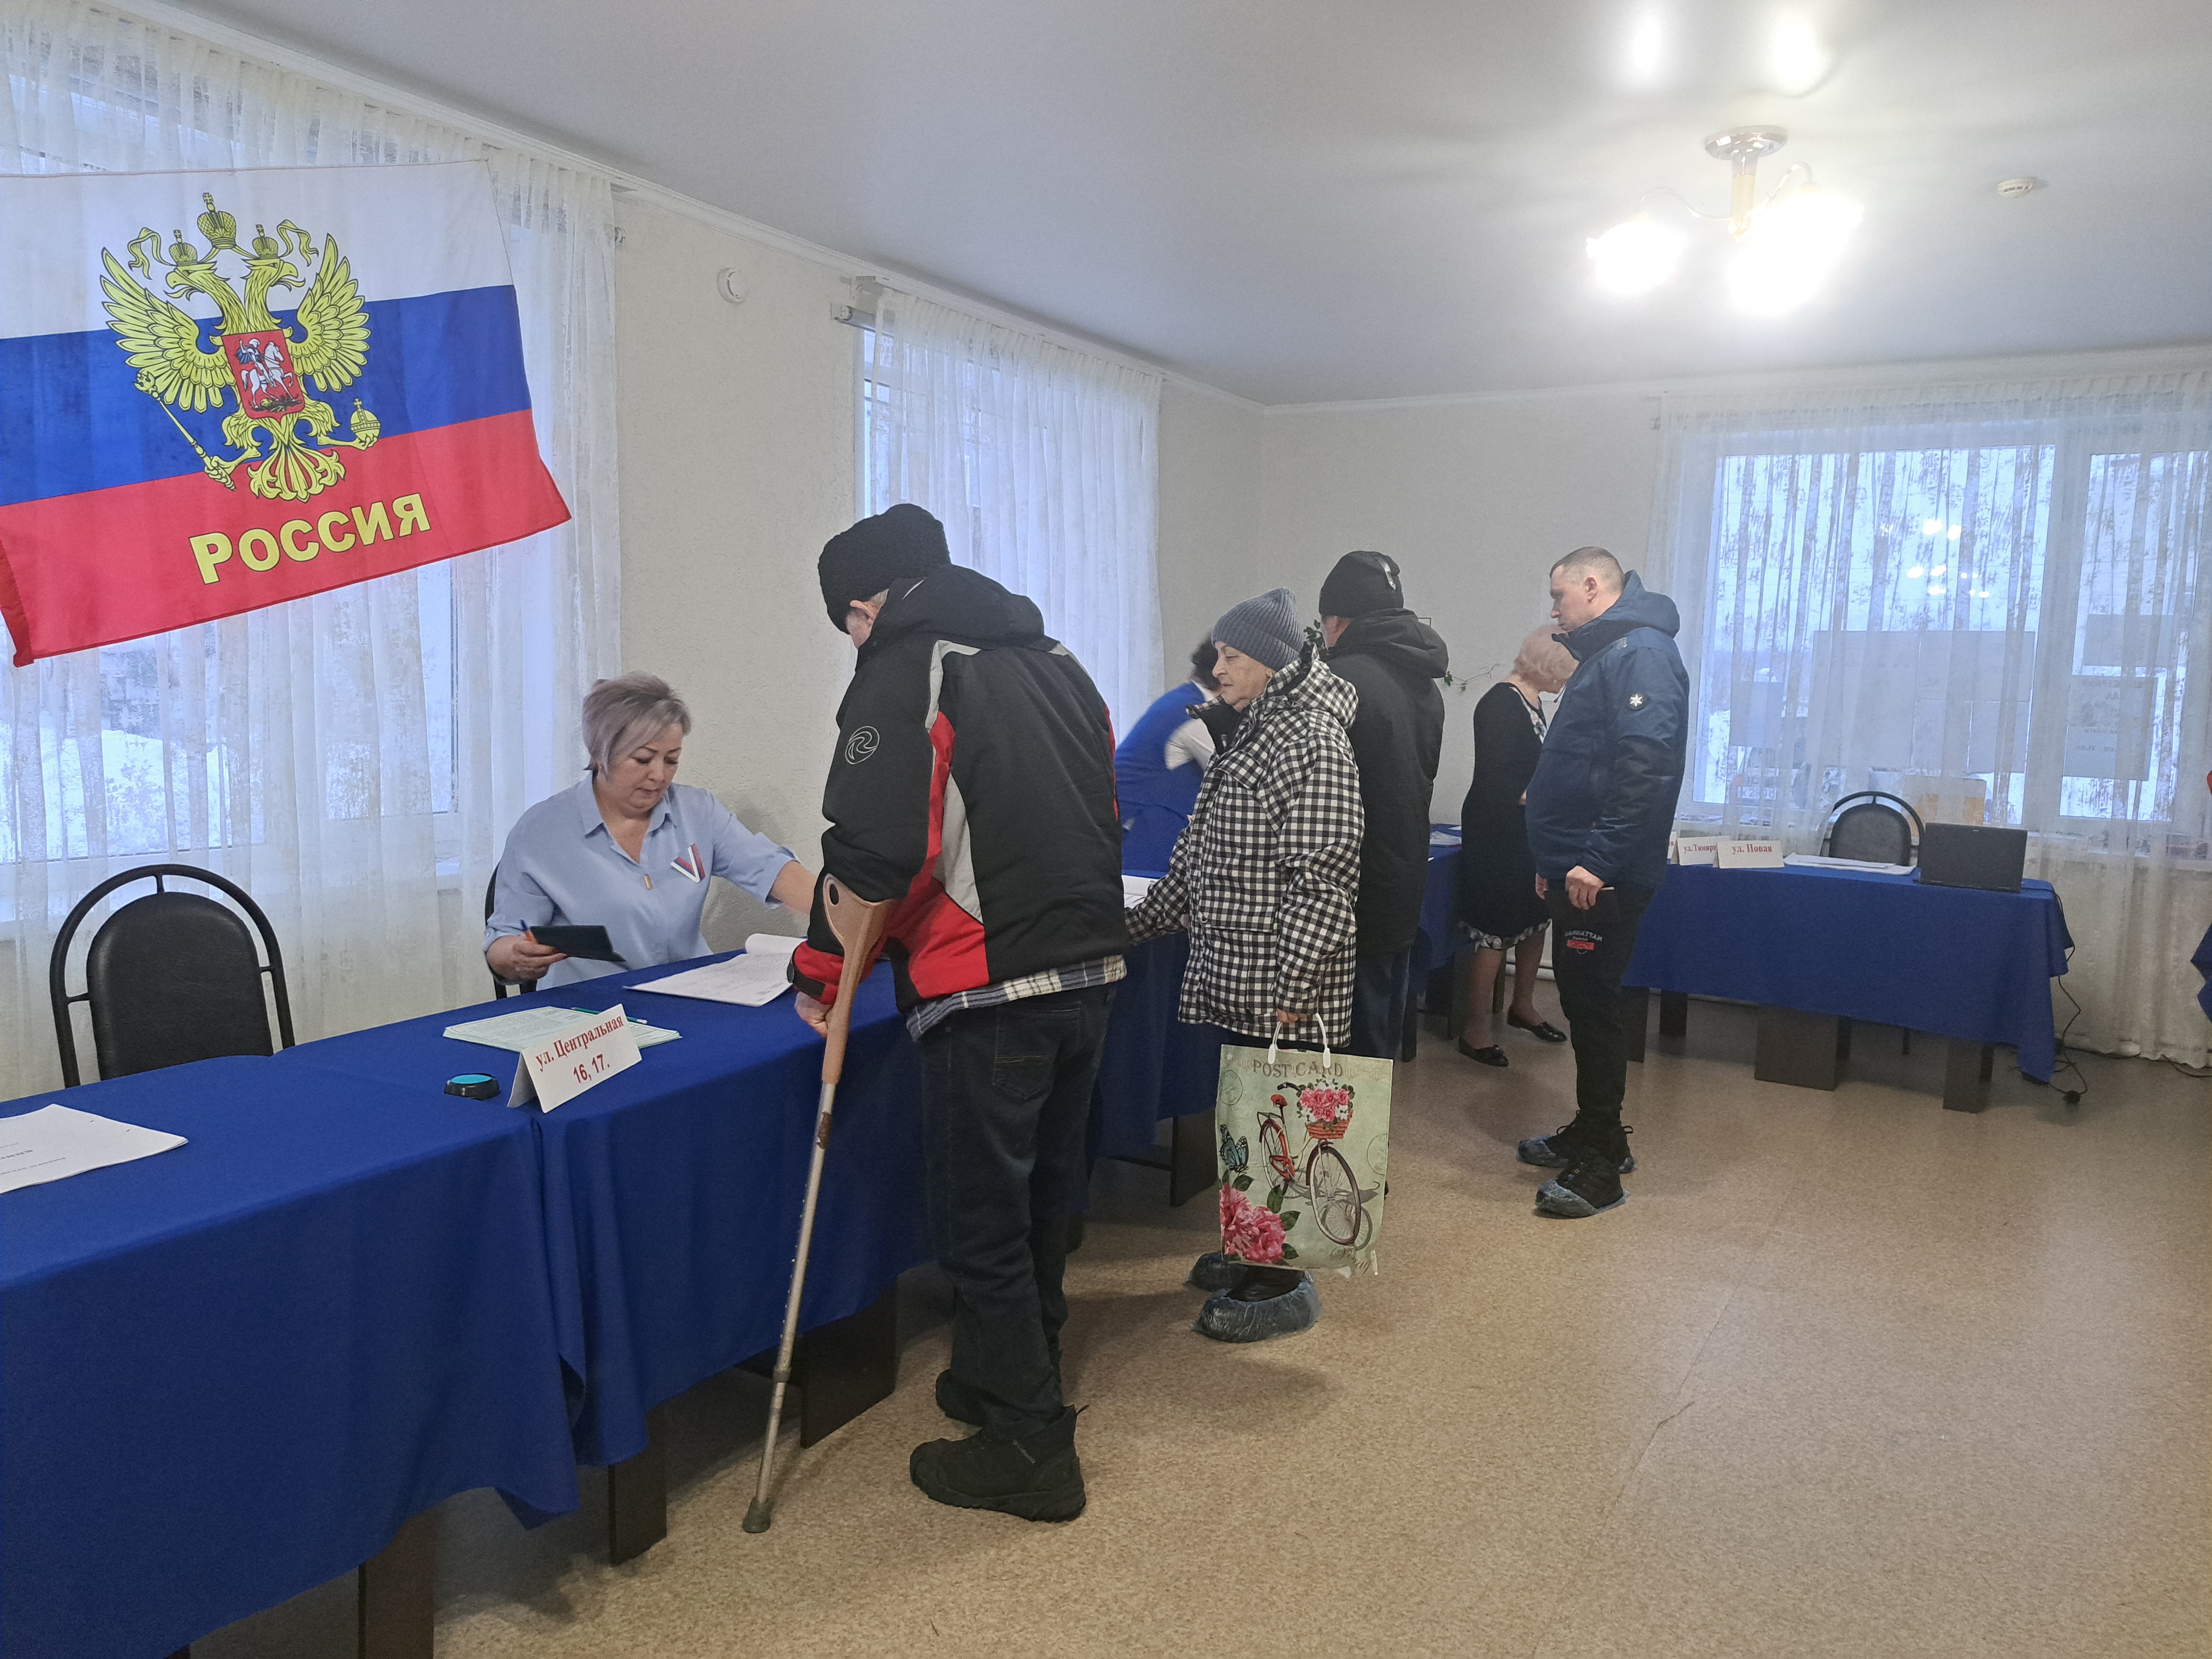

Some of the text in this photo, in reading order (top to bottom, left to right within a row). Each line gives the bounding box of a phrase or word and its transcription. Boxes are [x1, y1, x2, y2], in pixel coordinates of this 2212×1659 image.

[189, 493, 431, 585] РОССИЯ
[1732, 843, 1773, 855] ул. Новая
[535, 1051, 554, 1072] ул.
[553, 1015, 624, 1058] Центральная
[573, 1053, 610, 1084] 16, 17.
[1253, 1059, 1291, 1077] POST
